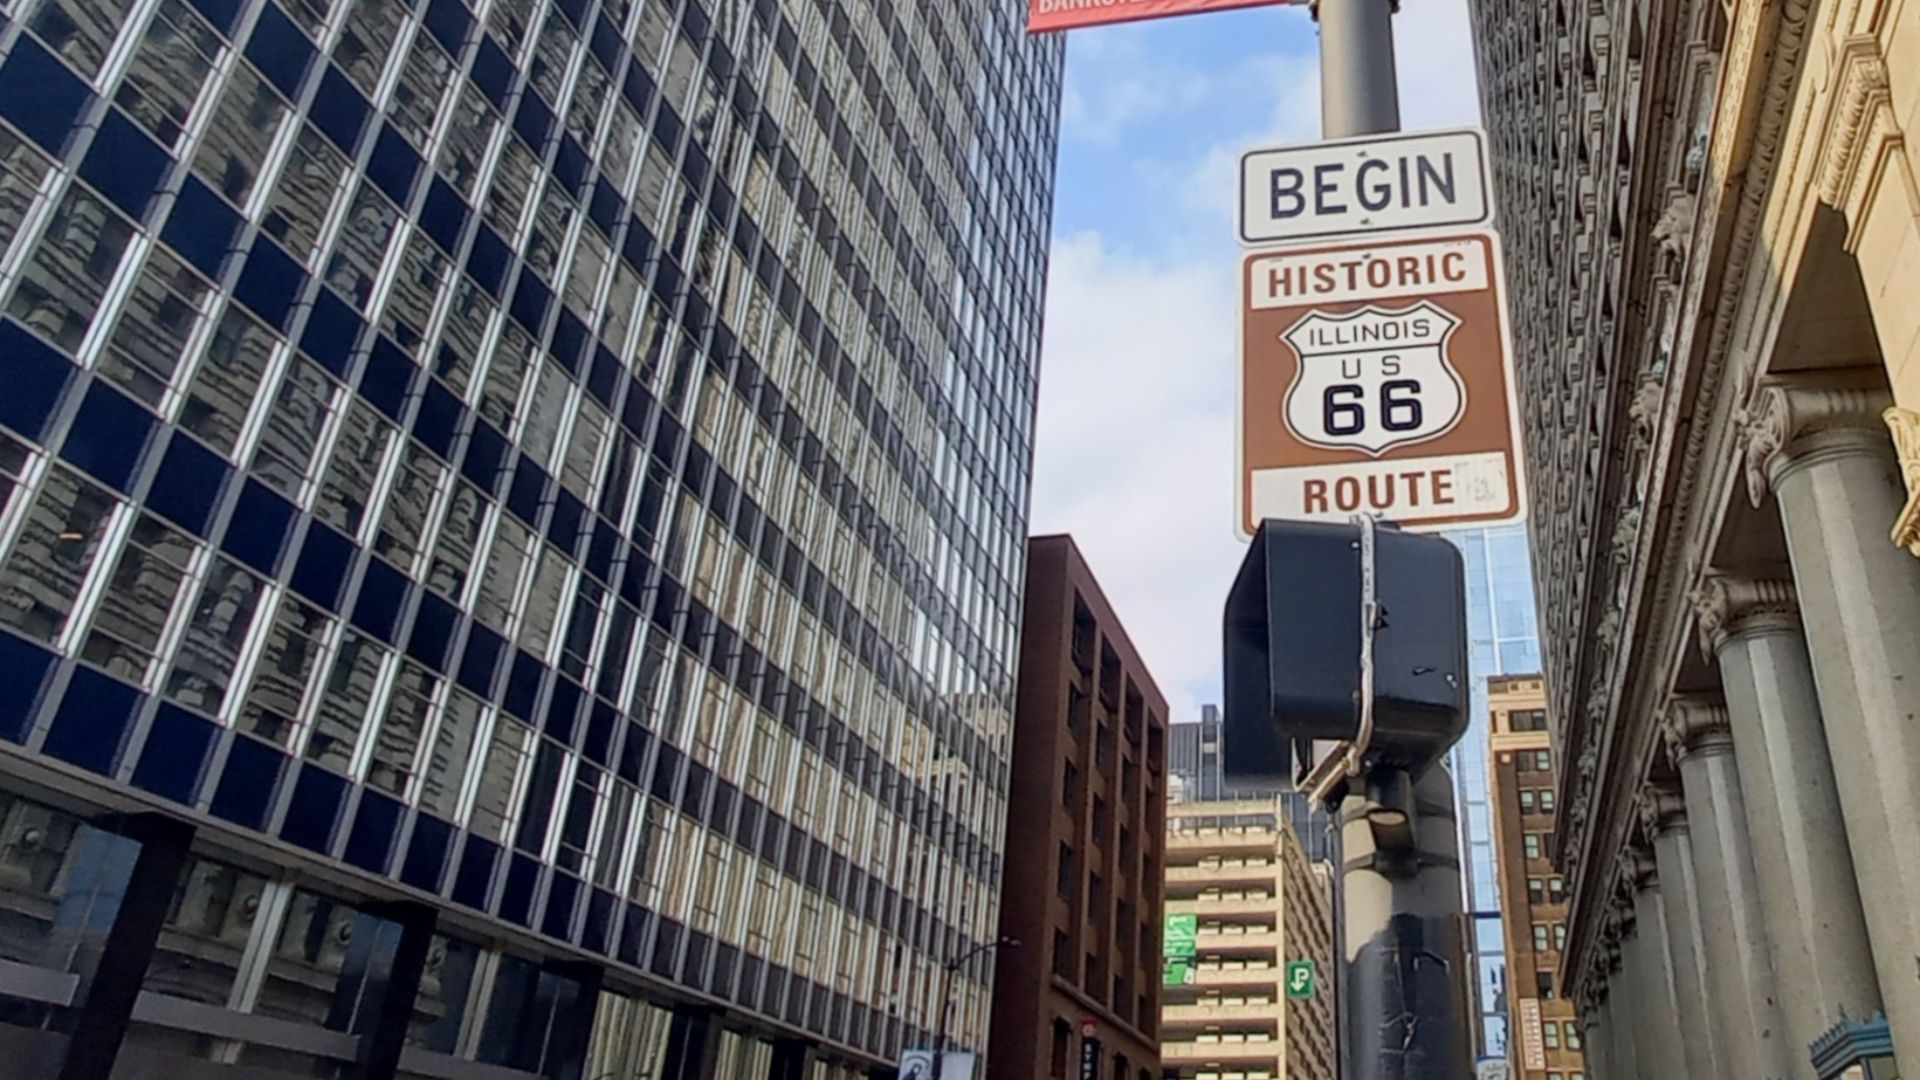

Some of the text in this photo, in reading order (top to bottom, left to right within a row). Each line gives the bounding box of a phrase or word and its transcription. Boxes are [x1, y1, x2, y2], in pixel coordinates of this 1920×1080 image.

[1270, 152, 1457, 220] BEGIN
[1268, 251, 1467, 298] HISTORIC
[1309, 318, 1431, 347] ILLINOIS
[1322, 378, 1423, 437] 66
[1303, 468, 1455, 514] ROUTE
